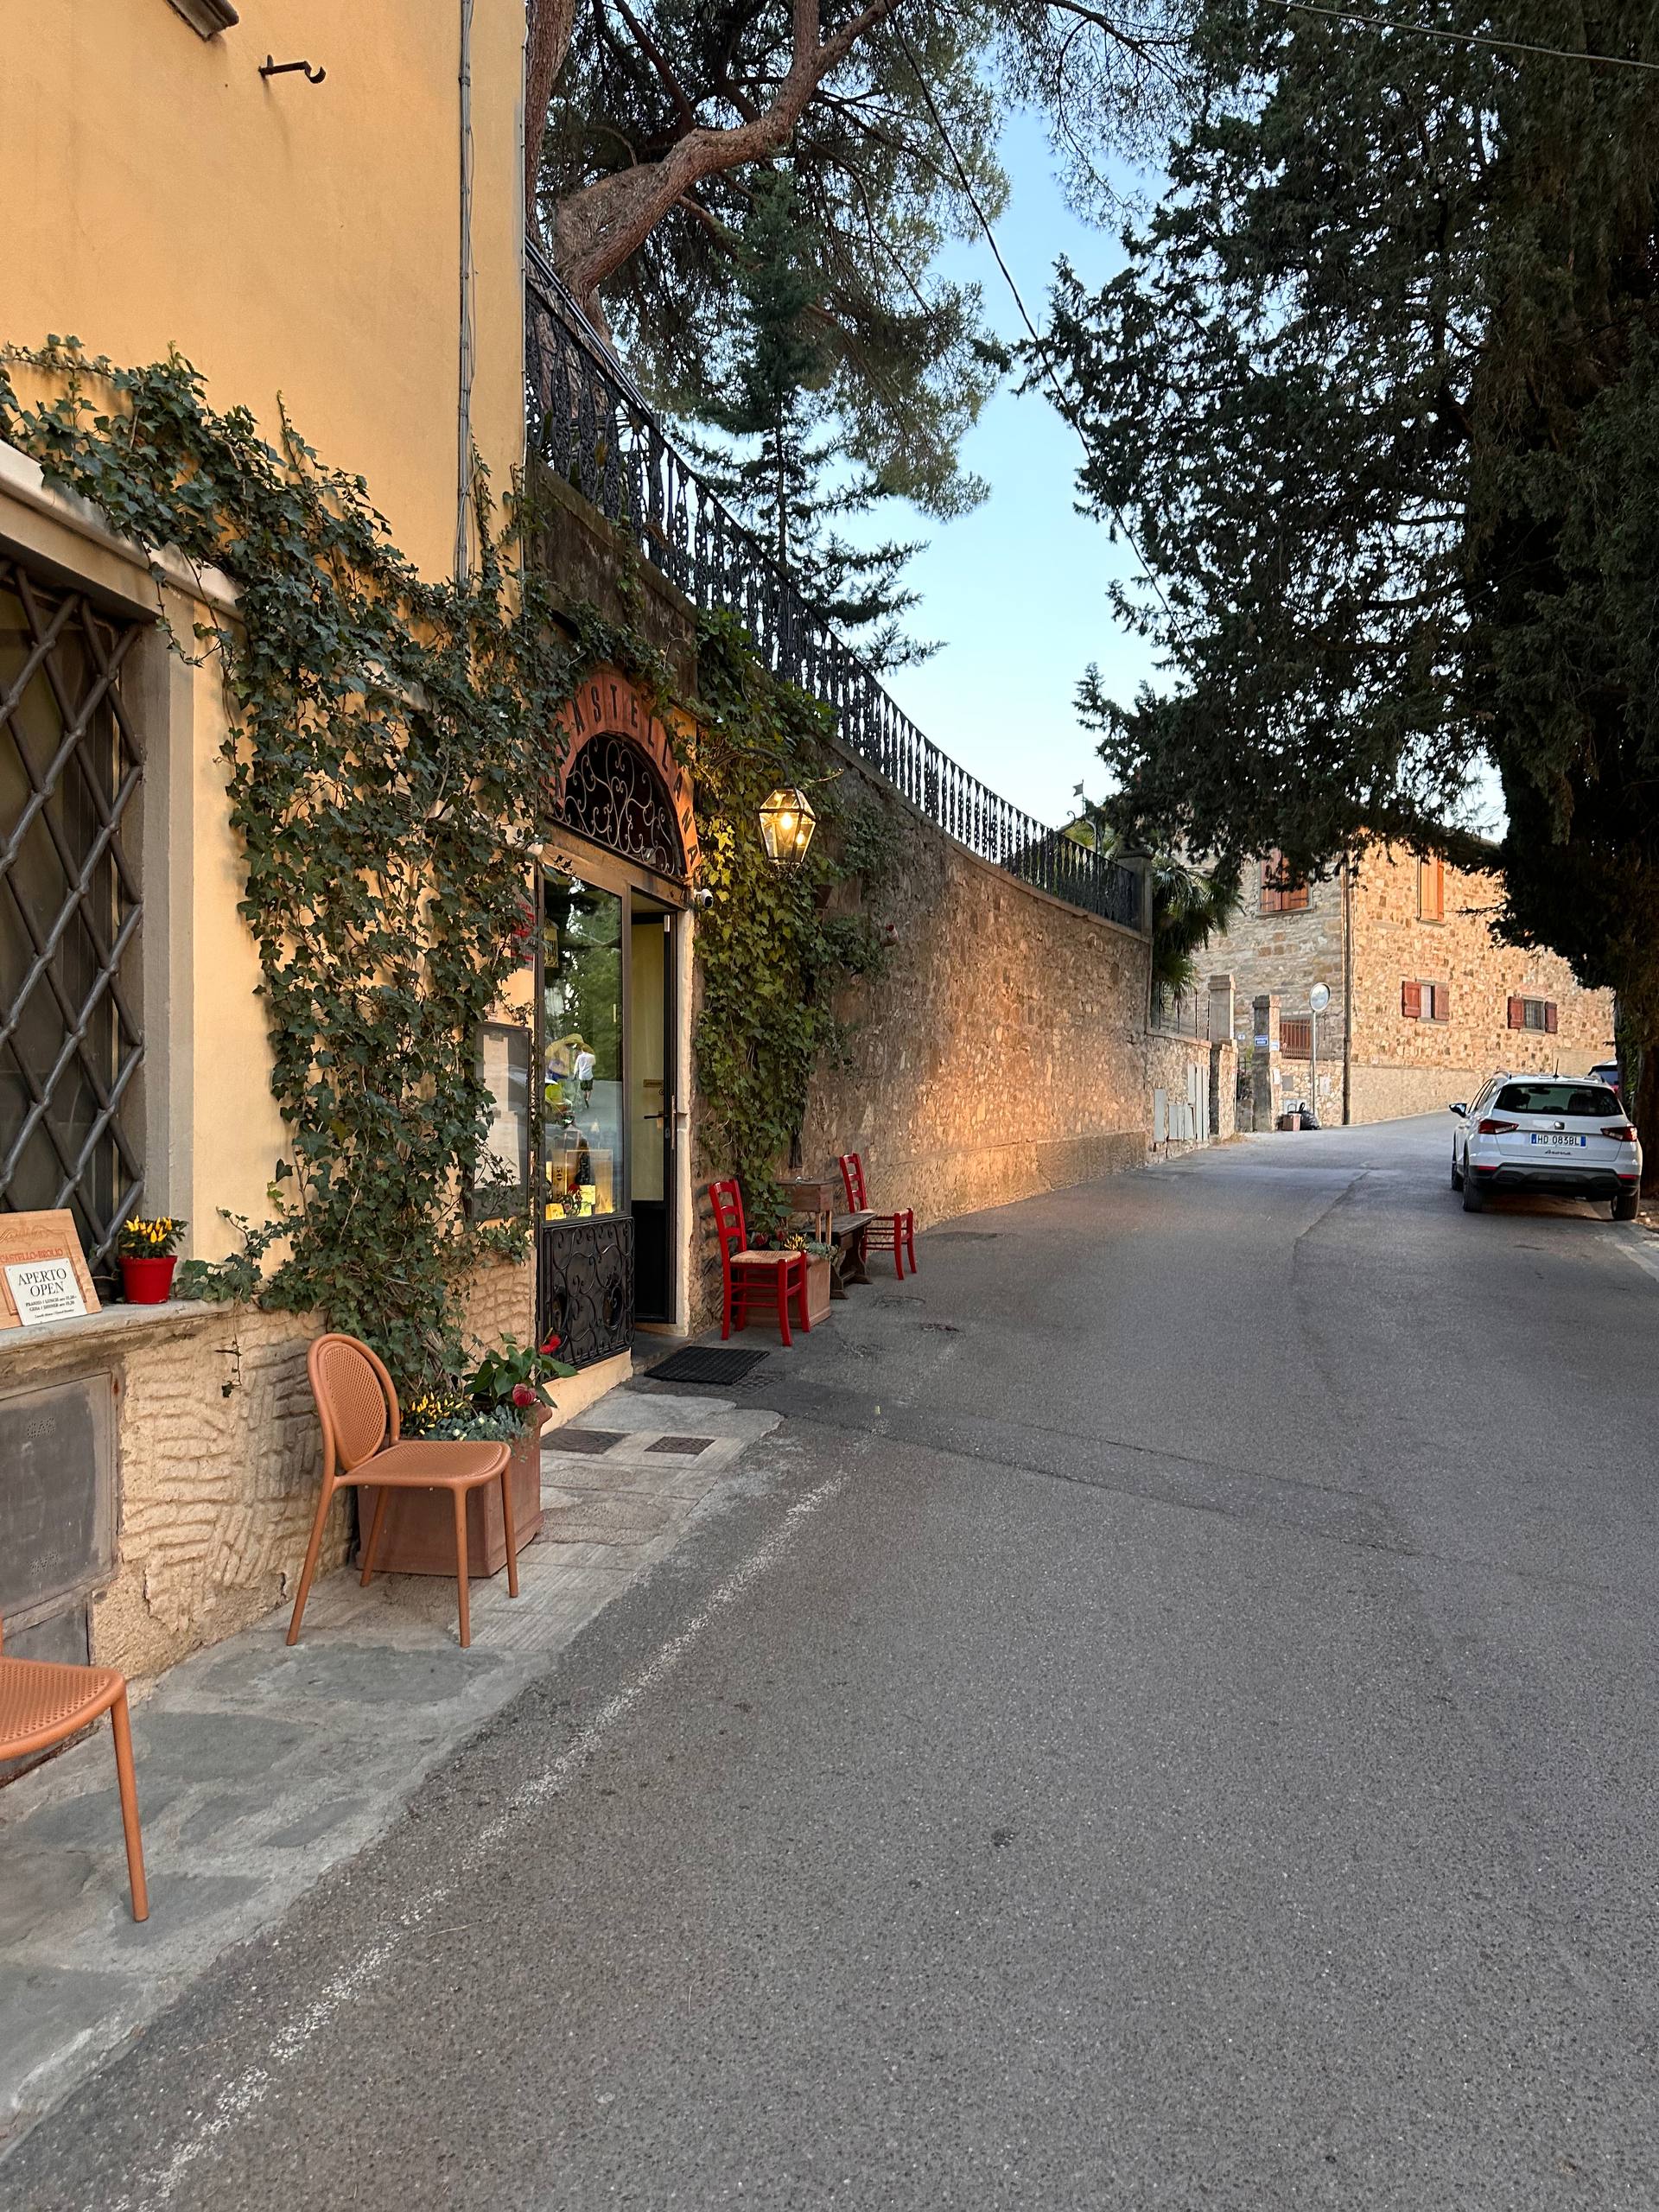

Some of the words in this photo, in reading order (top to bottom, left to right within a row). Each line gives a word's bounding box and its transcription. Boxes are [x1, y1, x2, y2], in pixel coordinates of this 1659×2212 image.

[554, 683, 699, 867] ASTELLANA
[18, 1268, 67, 1286] APERTO
[30, 1281, 64, 1297] OPEN
